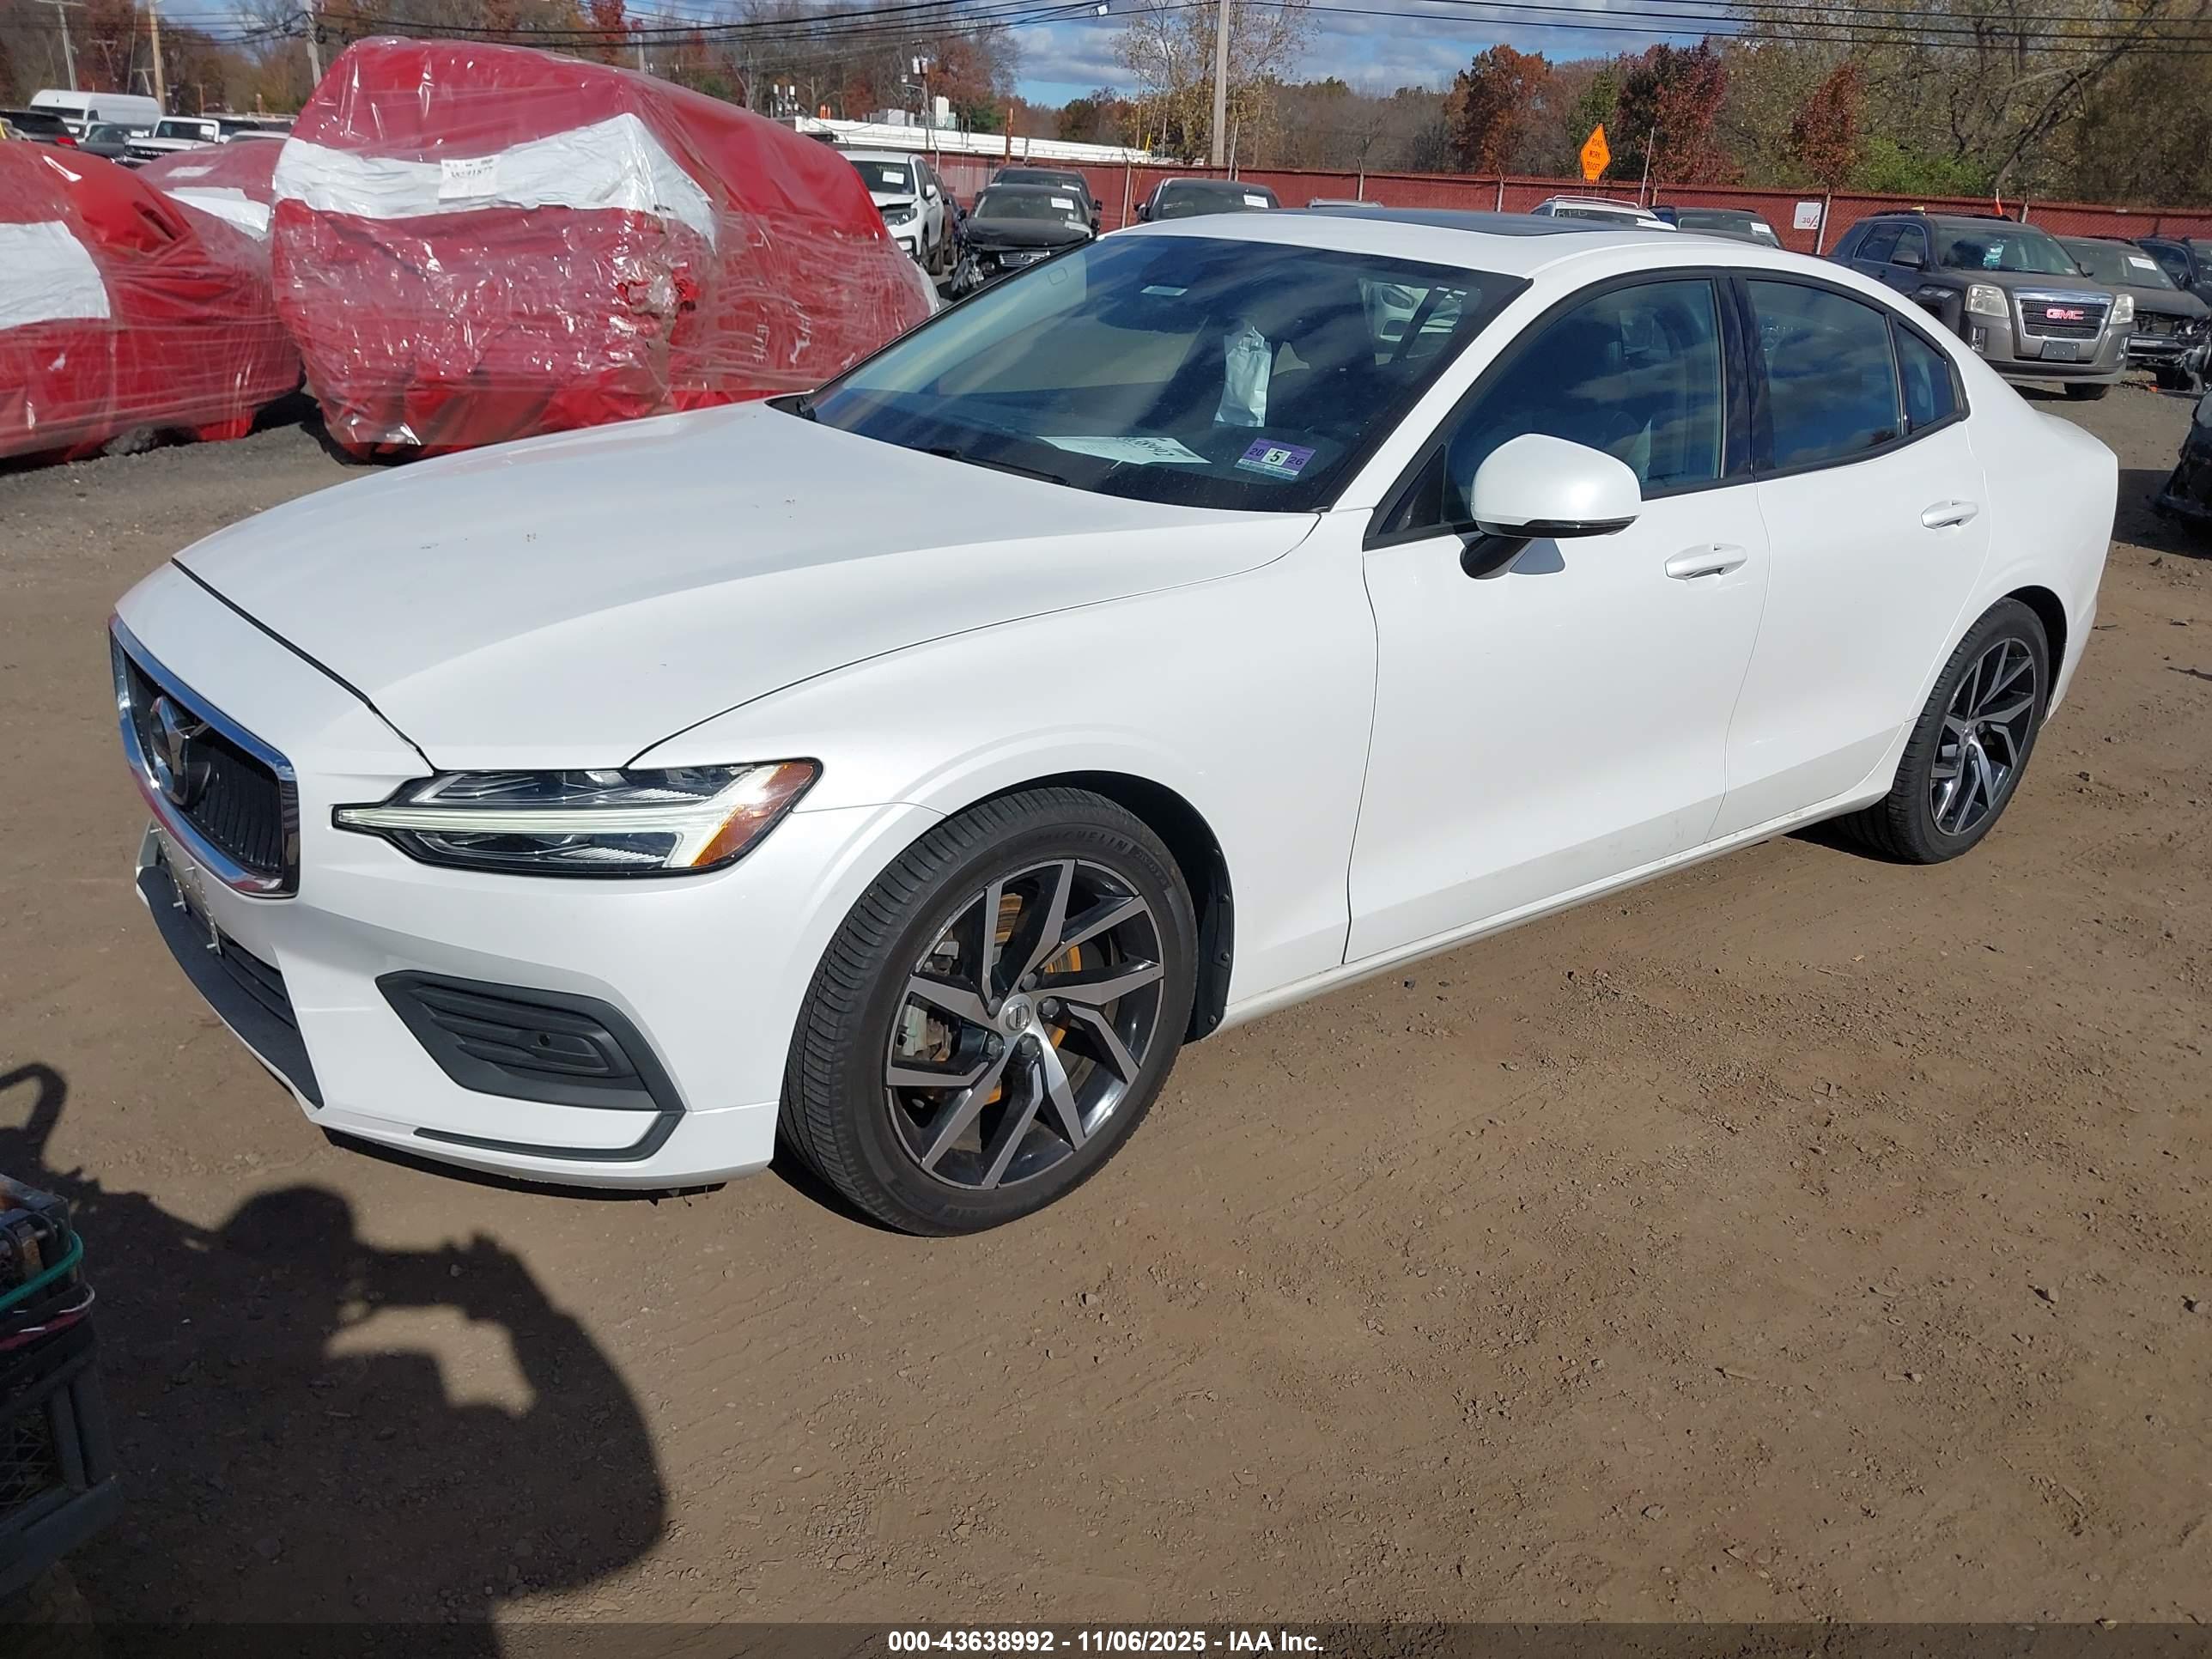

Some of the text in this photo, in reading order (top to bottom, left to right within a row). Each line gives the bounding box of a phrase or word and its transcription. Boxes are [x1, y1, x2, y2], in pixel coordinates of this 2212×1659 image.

[1591, 137, 1603, 148] ROAD
[1589, 150, 1601, 160] WORK
[2046, 308, 2084, 320] GMC
[1249, 447, 1304, 465] 20 5 26
[1036, 830, 1129, 853] MICHELIN
